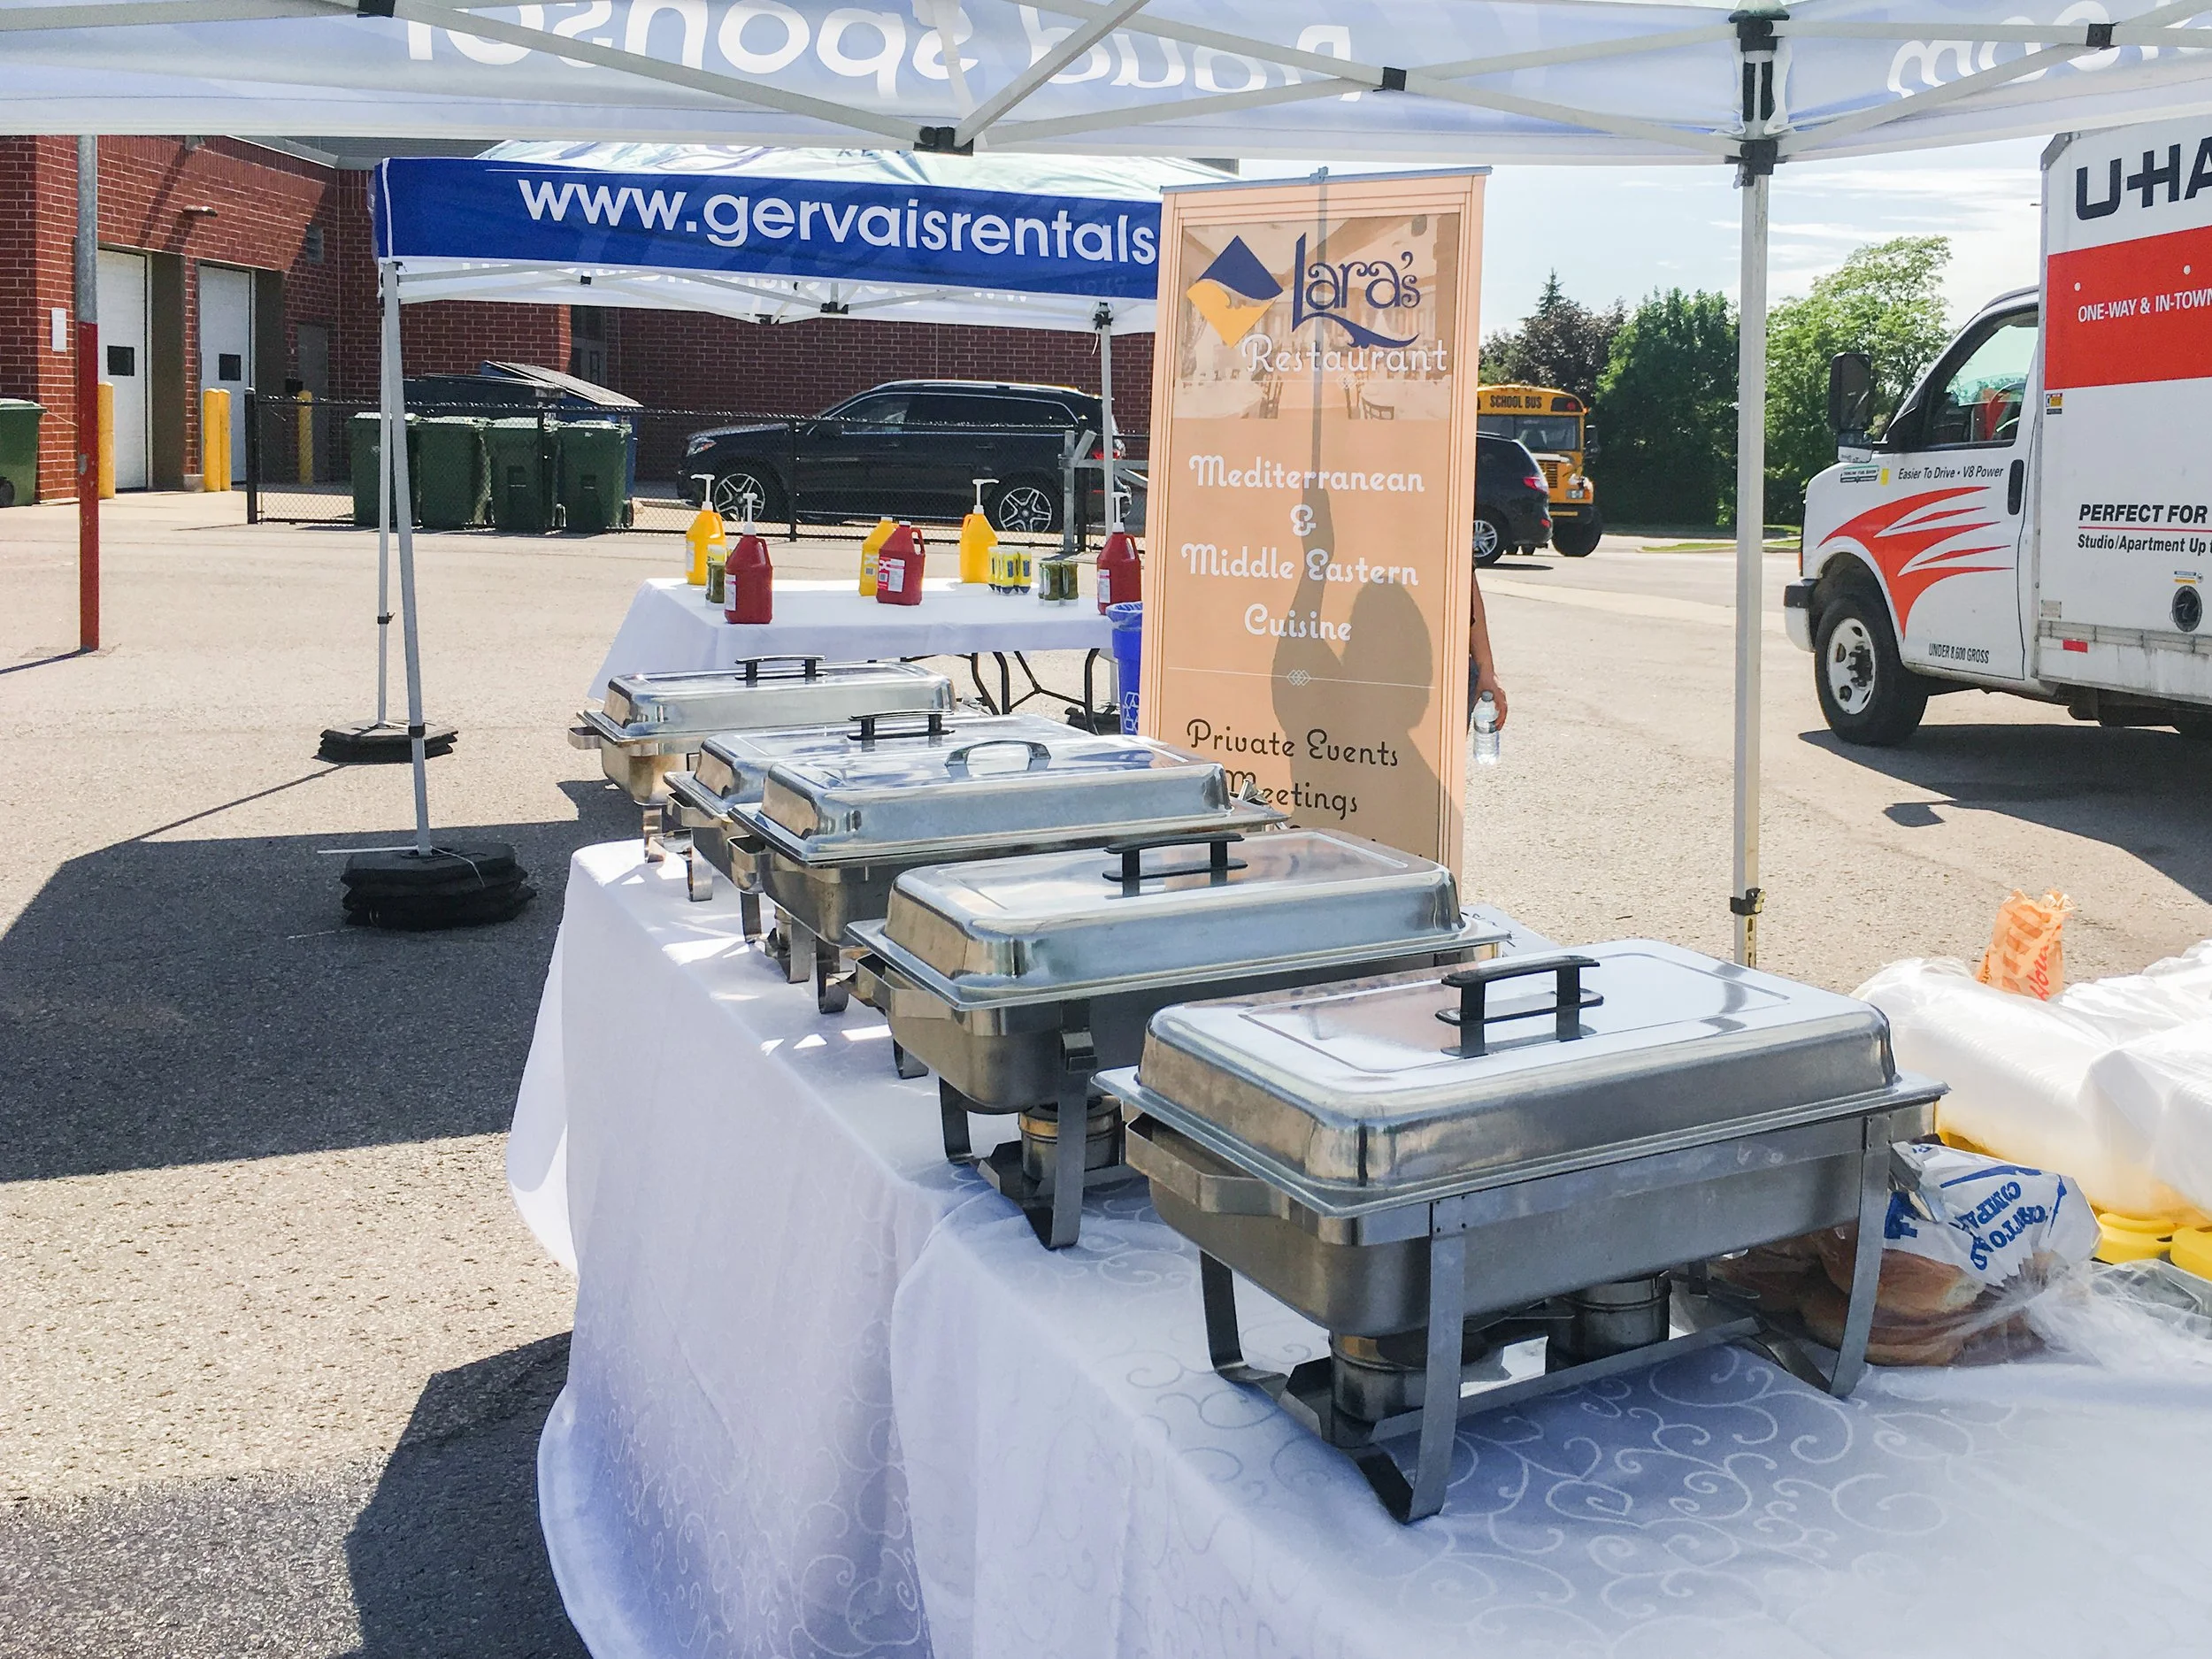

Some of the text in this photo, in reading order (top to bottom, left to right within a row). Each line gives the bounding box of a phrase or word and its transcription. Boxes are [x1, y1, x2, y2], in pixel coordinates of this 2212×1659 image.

[518, 179, 1156, 265] www.gervaisrentals
[1292, 232, 1420, 349] Lara's
[2078, 298, 2137, 323] ONE-WAY
[2139, 296, 2150, 314] &
[1240, 333, 1448, 373] Restaurant
[1490, 395, 1542, 409] SCHOOL BUS
[1188, 454, 1425, 493] Mediterranean
[1898, 465, 2004, 480] Easier To Drive V8 Power
[1289, 503, 1317, 537] &
[2078, 503, 2208, 524] PERFECT FOR
[2078, 534, 2185, 554] Studio/Apartment
[2189, 538, 2207, 557] Up
[1180, 542, 1419, 587] Middle Eastern
[1243, 603, 1353, 641] Cuisine
[1928, 642, 1950, 658] UNDER
[1966, 648, 1990, 664] GROSS
[1186, 718, 1399, 767] Private Events
